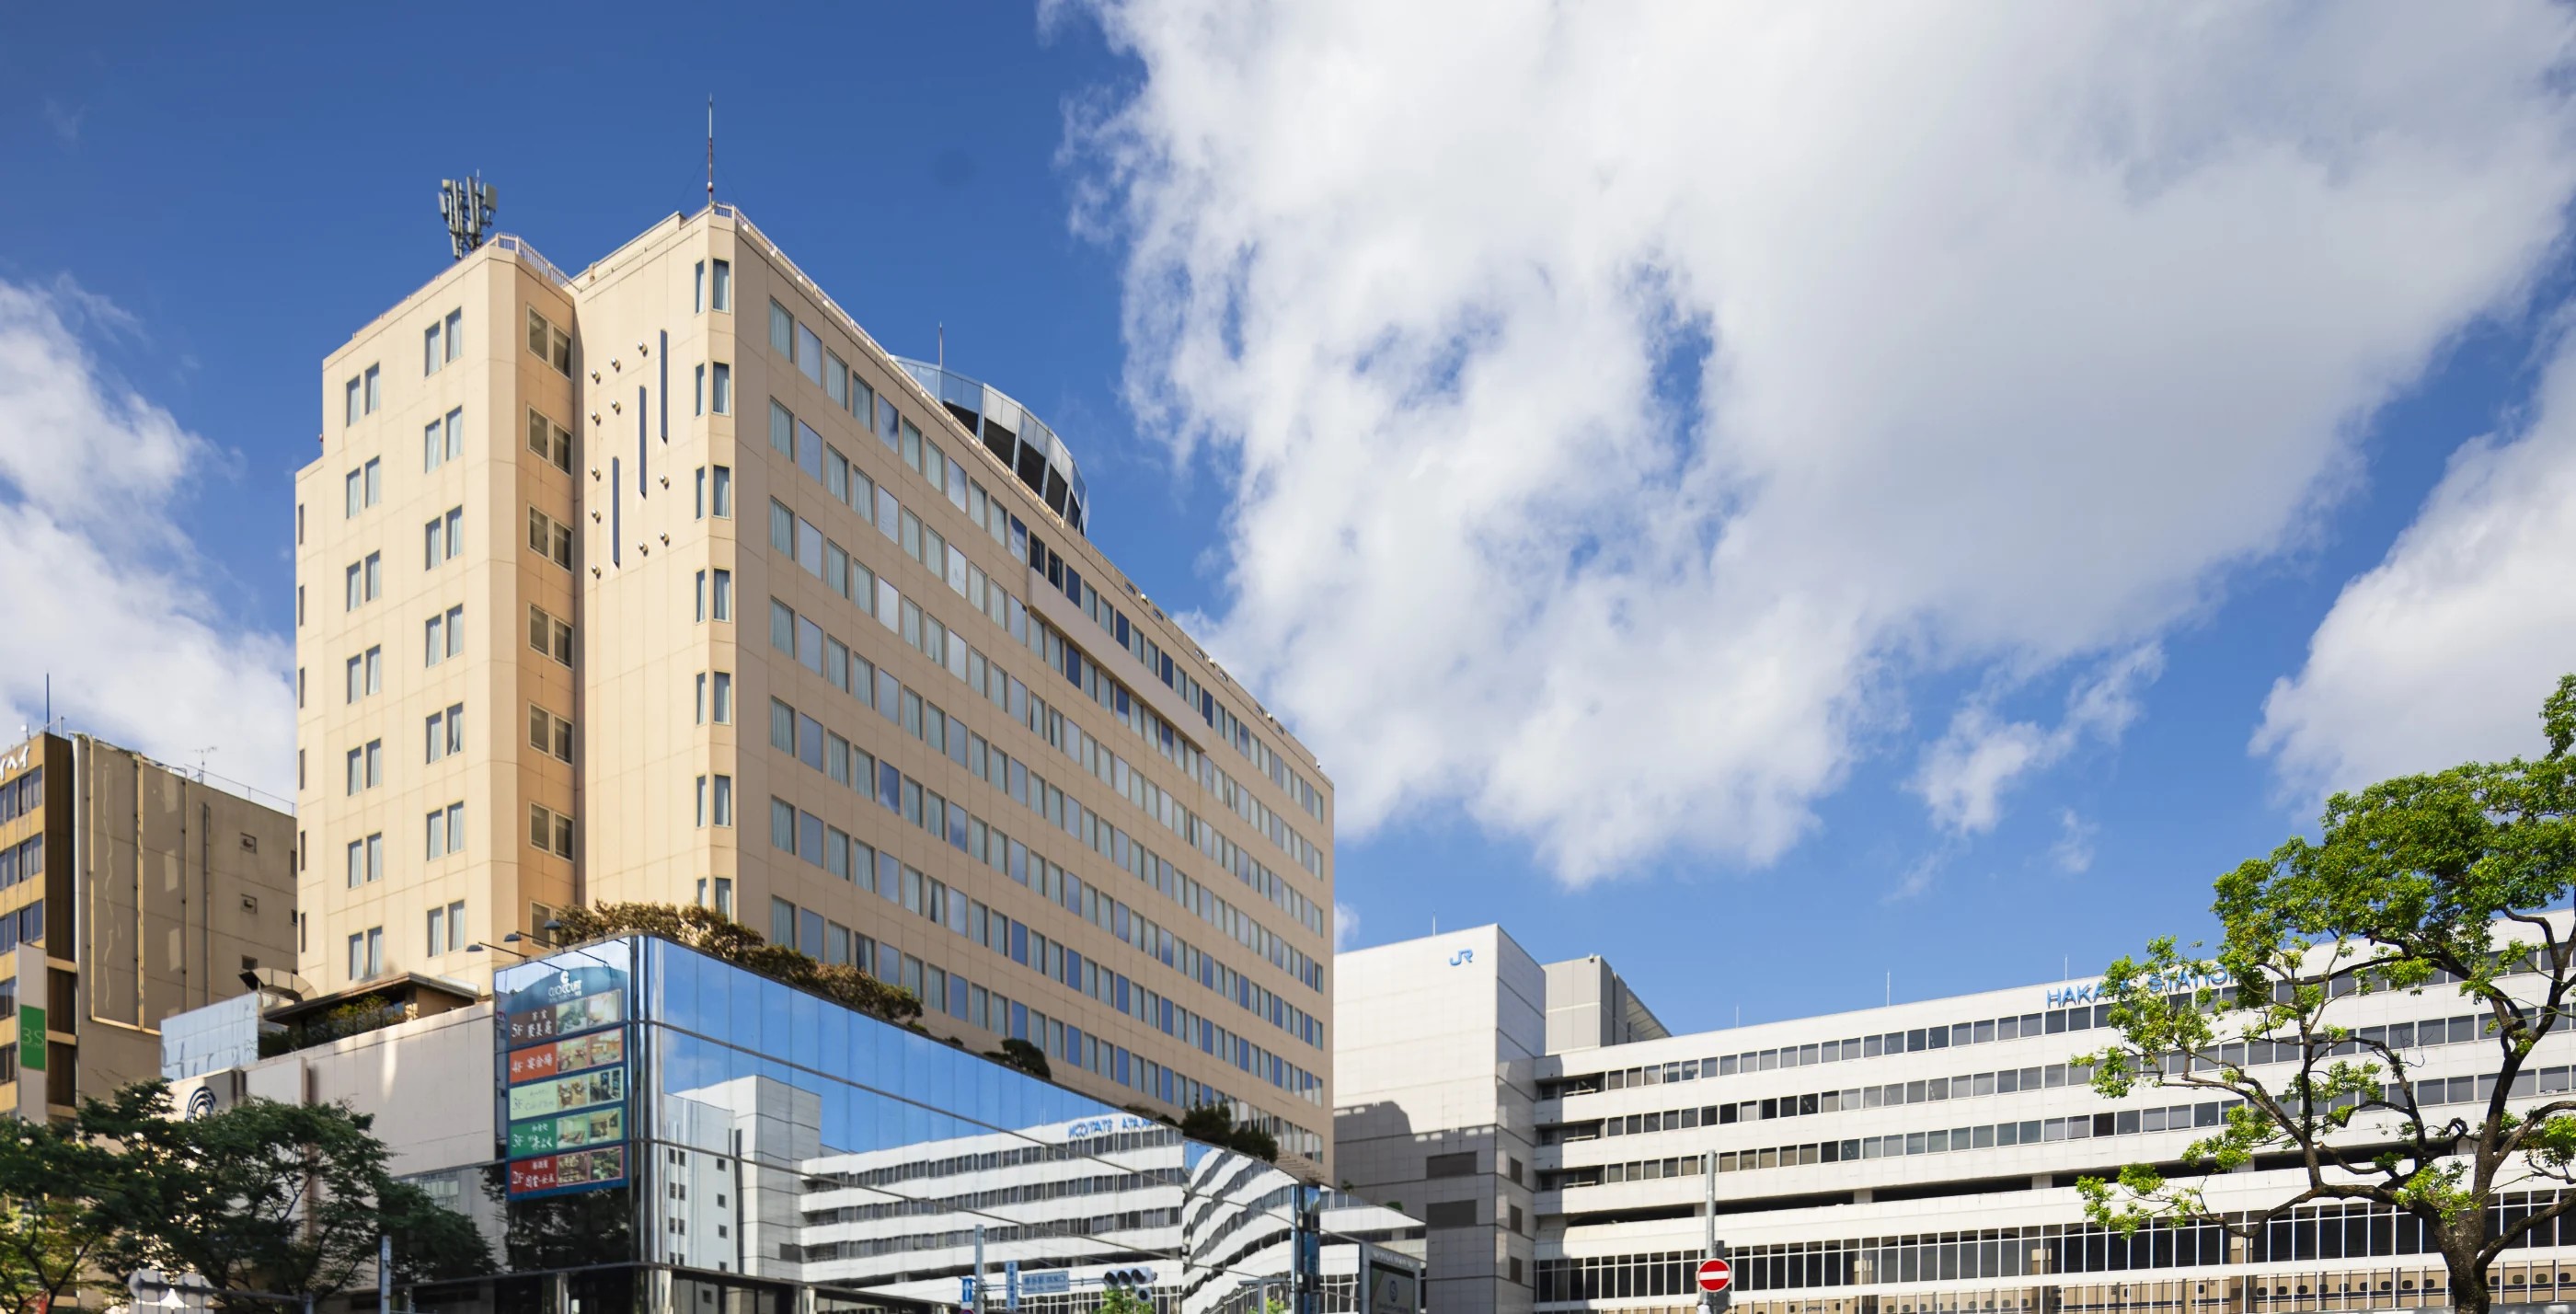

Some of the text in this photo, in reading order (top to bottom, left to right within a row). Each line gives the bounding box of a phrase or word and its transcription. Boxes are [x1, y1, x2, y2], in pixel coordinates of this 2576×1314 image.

[1449, 948, 1474, 966] JR
[512, 1023, 523, 1038] 5F
[512, 1060, 523, 1073] 4F
[512, 1097, 523, 1111] 3F
[512, 1133, 523, 1147] 3F
[512, 1170, 523, 1185] 2F
